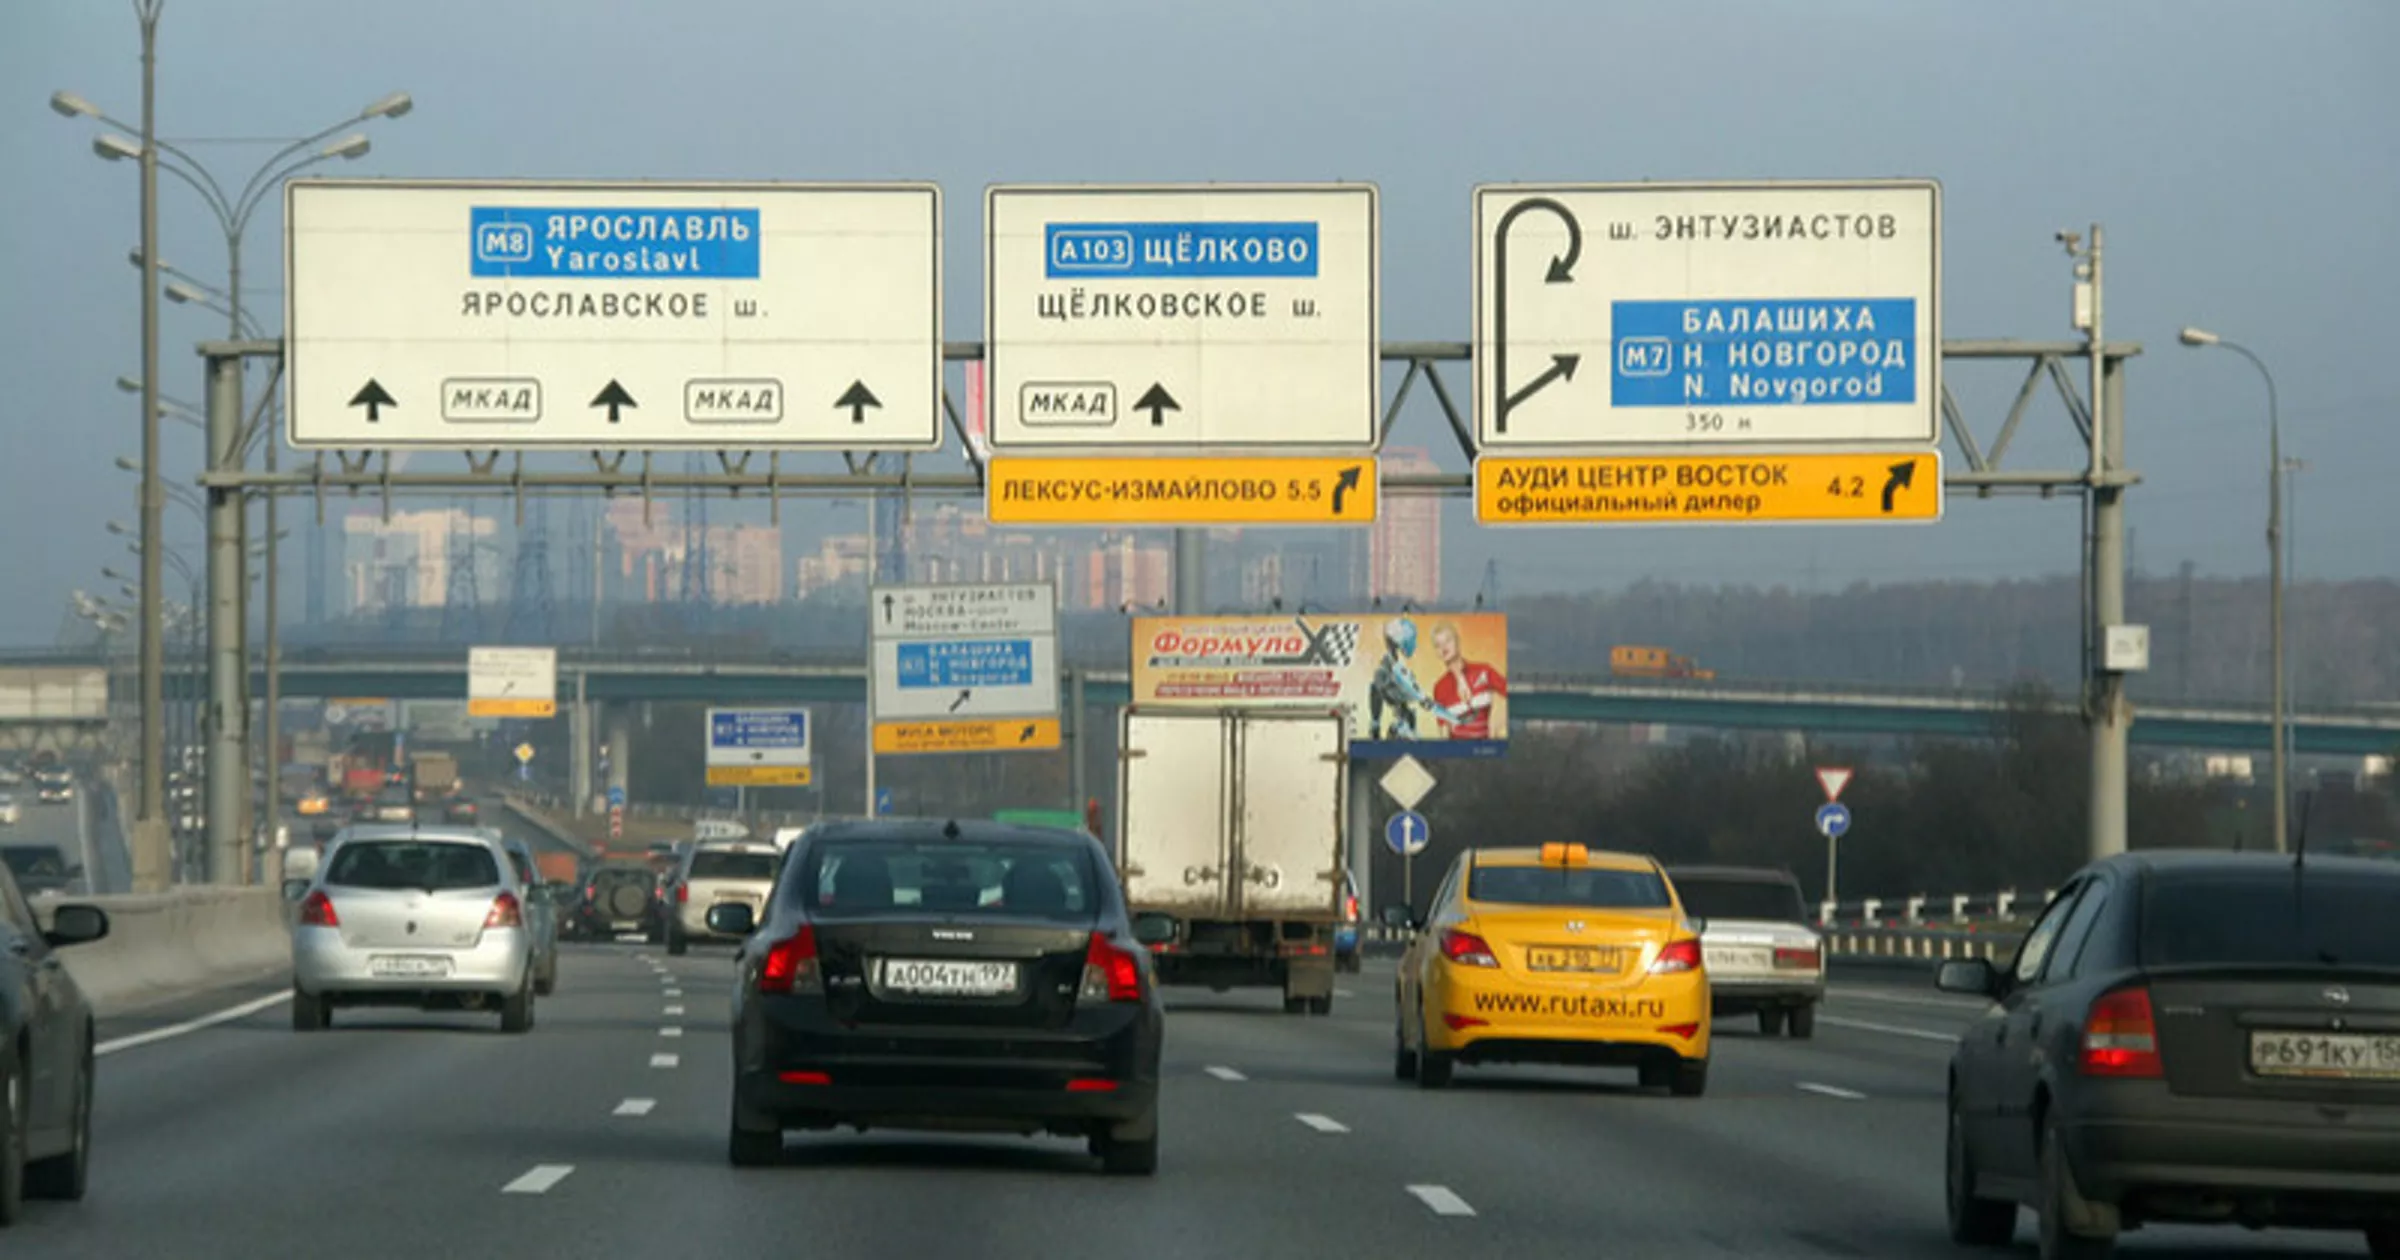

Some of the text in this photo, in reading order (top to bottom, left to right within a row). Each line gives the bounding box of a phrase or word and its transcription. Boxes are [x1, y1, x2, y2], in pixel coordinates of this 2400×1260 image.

[546, 215, 749, 242] ЯРОСЛАВЛЬ
[1609, 214, 1896, 240] ш. ЭНТУЗИАСТОВ
[546, 247, 700, 272] Yaroslavl
[1144, 232, 1308, 265] ЩЁЛКОВО
[462, 291, 769, 318] ЯРОСЛАВСКОЕ ш.
[1038, 287, 1320, 320] ЩЁЛКОВСКОЕ ш.
[1683, 307, 1876, 333] БАЛАШИХА
[1683, 340, 1906, 368] Н. НОВГОРОД
[452, 388, 774, 412] МКАД МКАД
[1684, 372, 1883, 402] N. Novgorod
[1029, 392, 1107, 415] МКАД
[1686, 413, 1724, 432] 350
[1003, 475, 1321, 502] ЛЕКСУС-ИЗМАЙЛОВО 5.5
[1497, 463, 1788, 491] АУДИ ЦЕНТР ВОСТОК
[1827, 476, 1865, 498] 4.2
[1497, 491, 1761, 515] официальный дилер
[1153, 630, 1304, 658] Формула
[1474, 993, 1664, 1018] www.rutaxi.ru
[2373, 1039, 2400, 1060] 15
